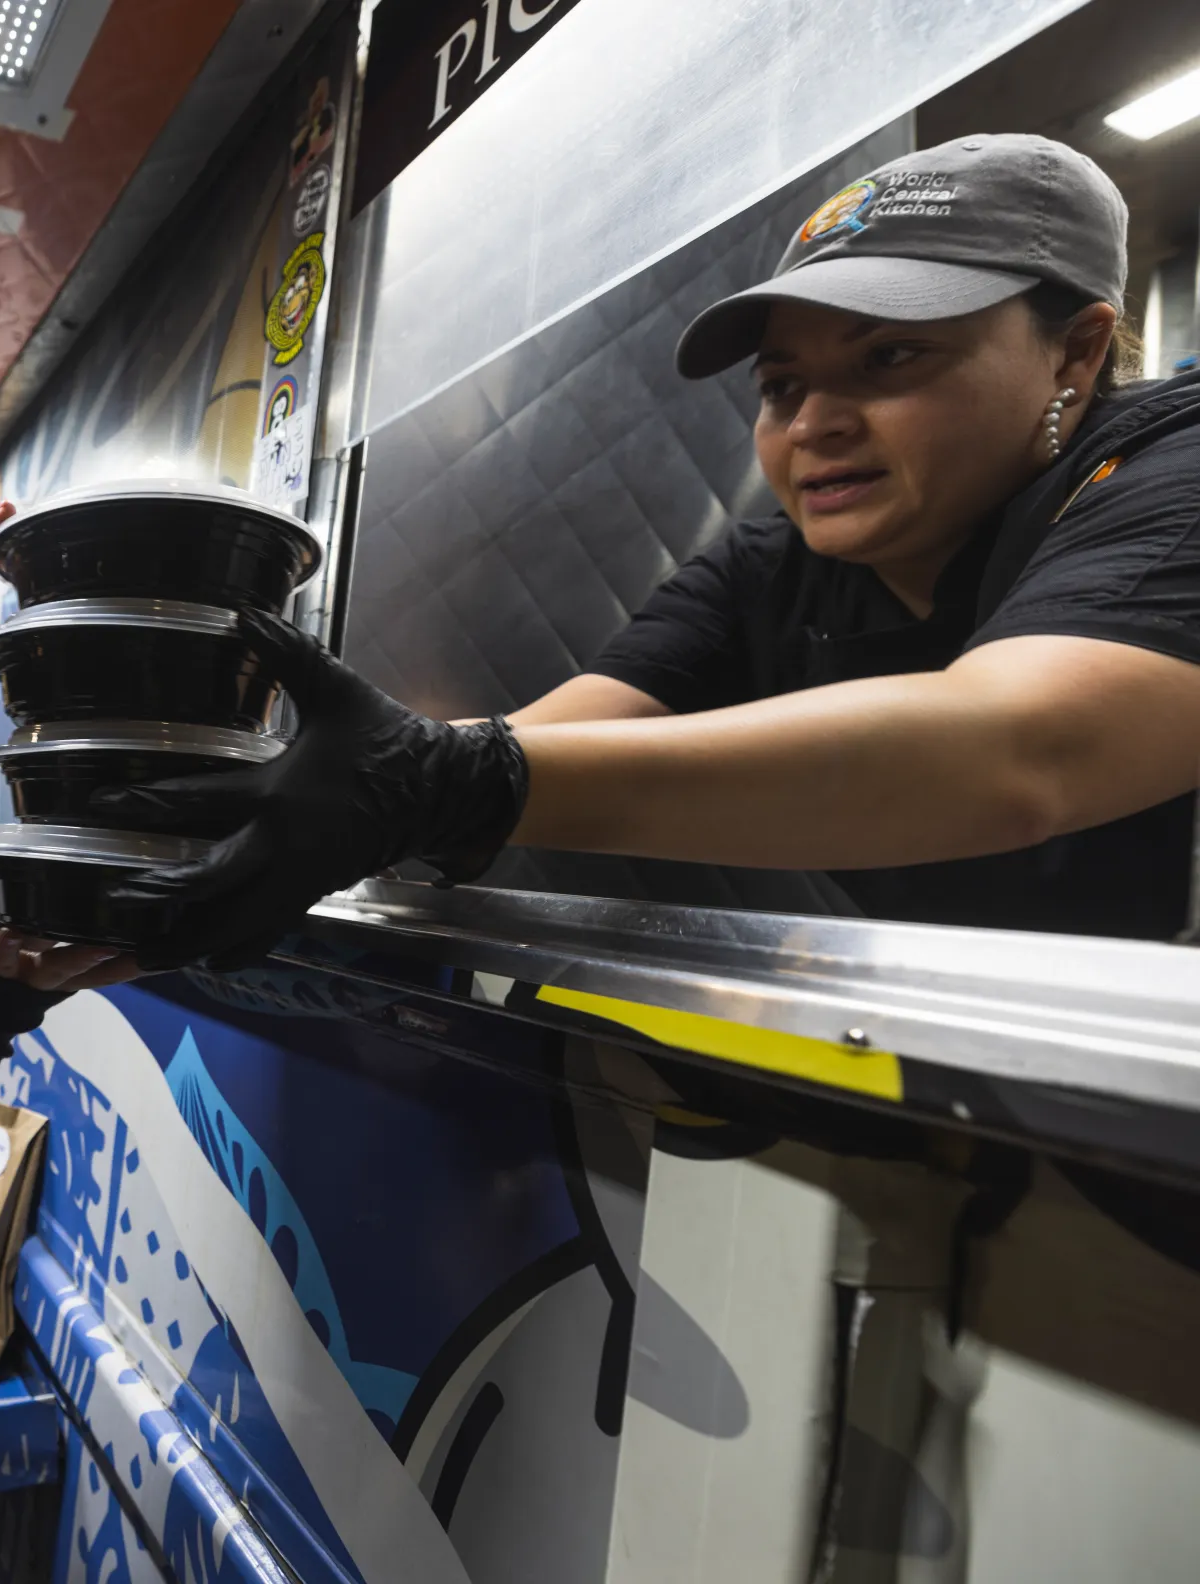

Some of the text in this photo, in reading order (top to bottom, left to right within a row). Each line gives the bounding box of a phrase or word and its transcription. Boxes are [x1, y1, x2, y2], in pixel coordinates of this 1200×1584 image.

[888, 171, 947, 188] World
[880, 187, 958, 202] Central
[869, 200, 951, 218] Kitchen
